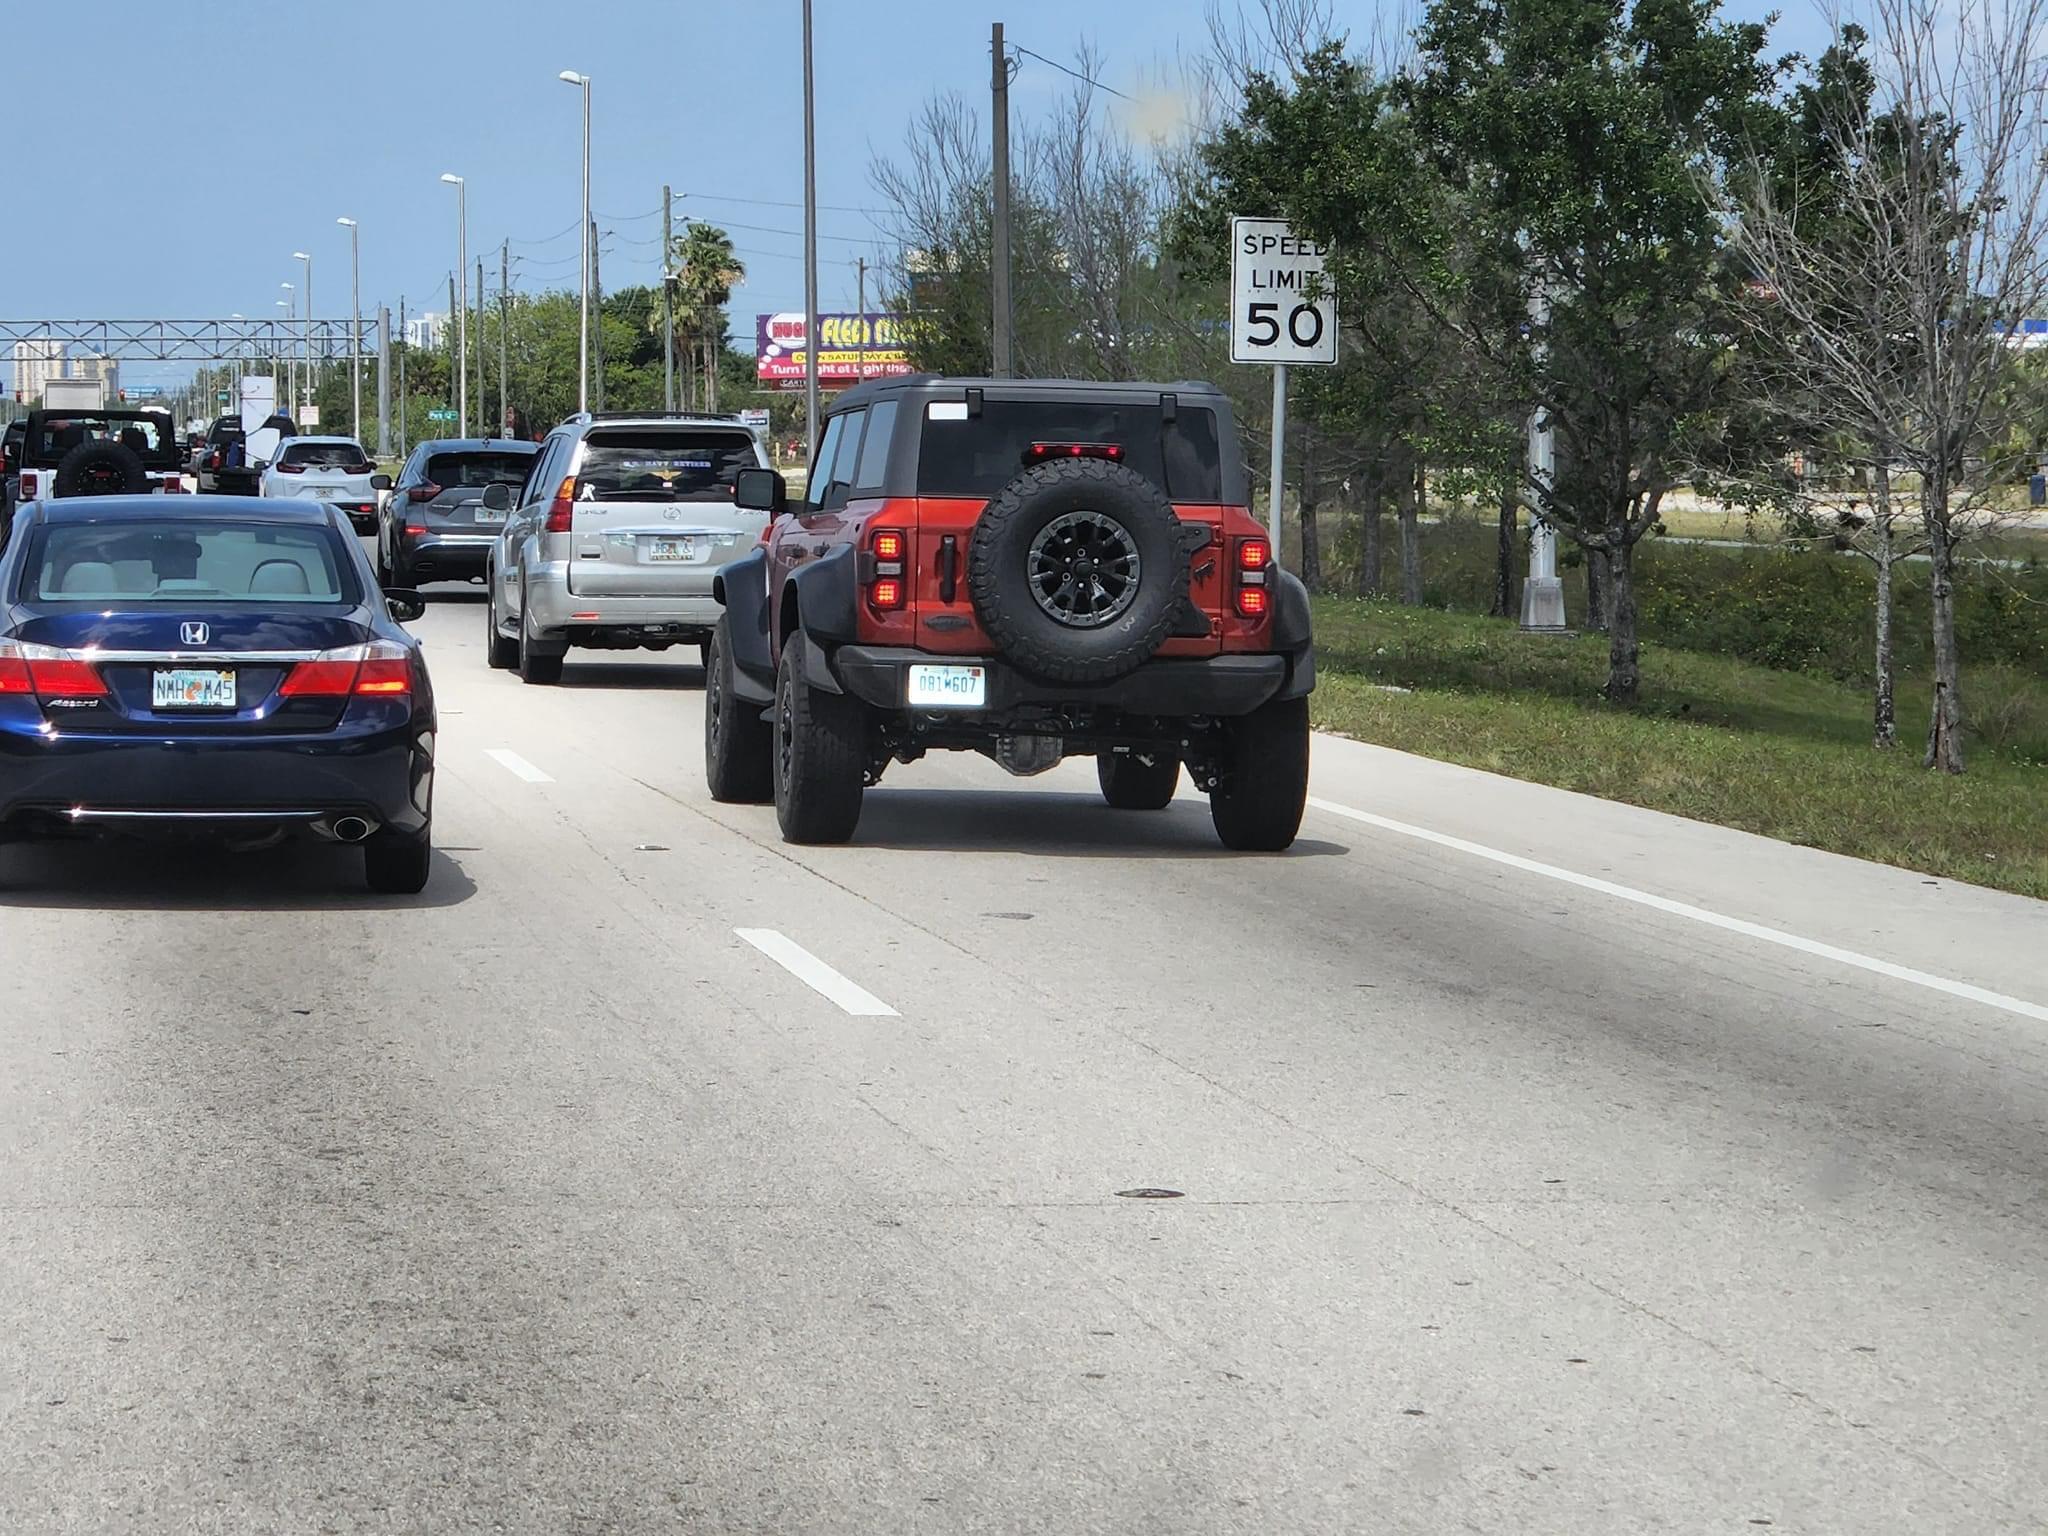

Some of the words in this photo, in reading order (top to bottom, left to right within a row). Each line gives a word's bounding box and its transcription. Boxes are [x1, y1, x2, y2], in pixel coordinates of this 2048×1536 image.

[1244, 235, 1328, 256] SPEED
[821, 318, 871, 345] FLEA
[1247, 302, 1324, 347] 50
[771, 365, 800, 374] Turn
[156, 680, 185, 699] NMH
[204, 680, 232, 699] M45
